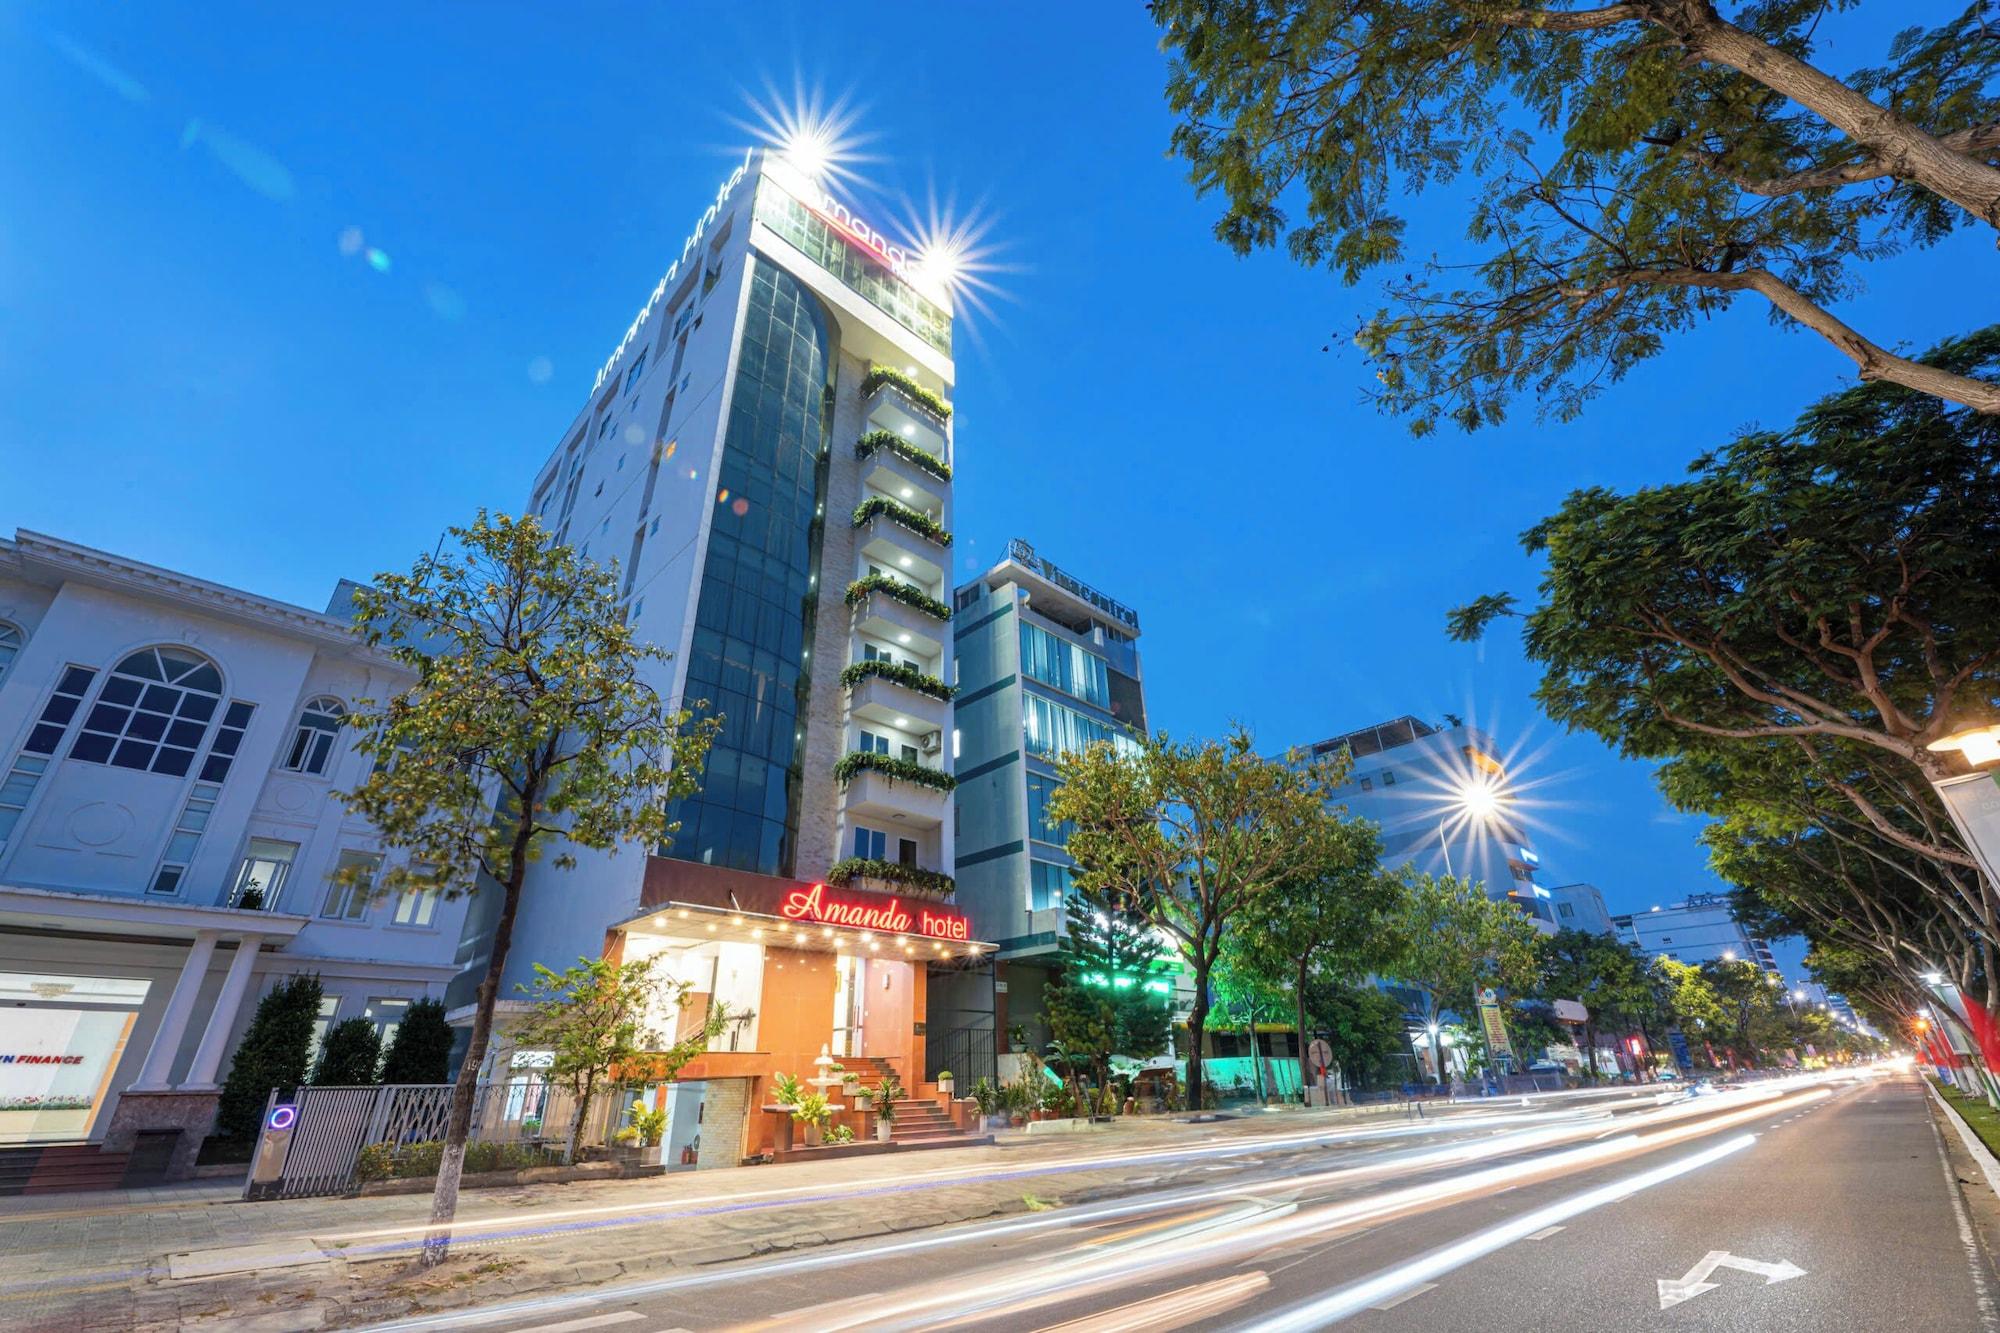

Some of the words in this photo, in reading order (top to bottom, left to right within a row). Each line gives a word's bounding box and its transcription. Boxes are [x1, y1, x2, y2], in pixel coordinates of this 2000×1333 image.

[783, 883, 912, 931] Amanda
[922, 911, 968, 940] hotel
[16, 1055, 84, 1065] FINANCE
